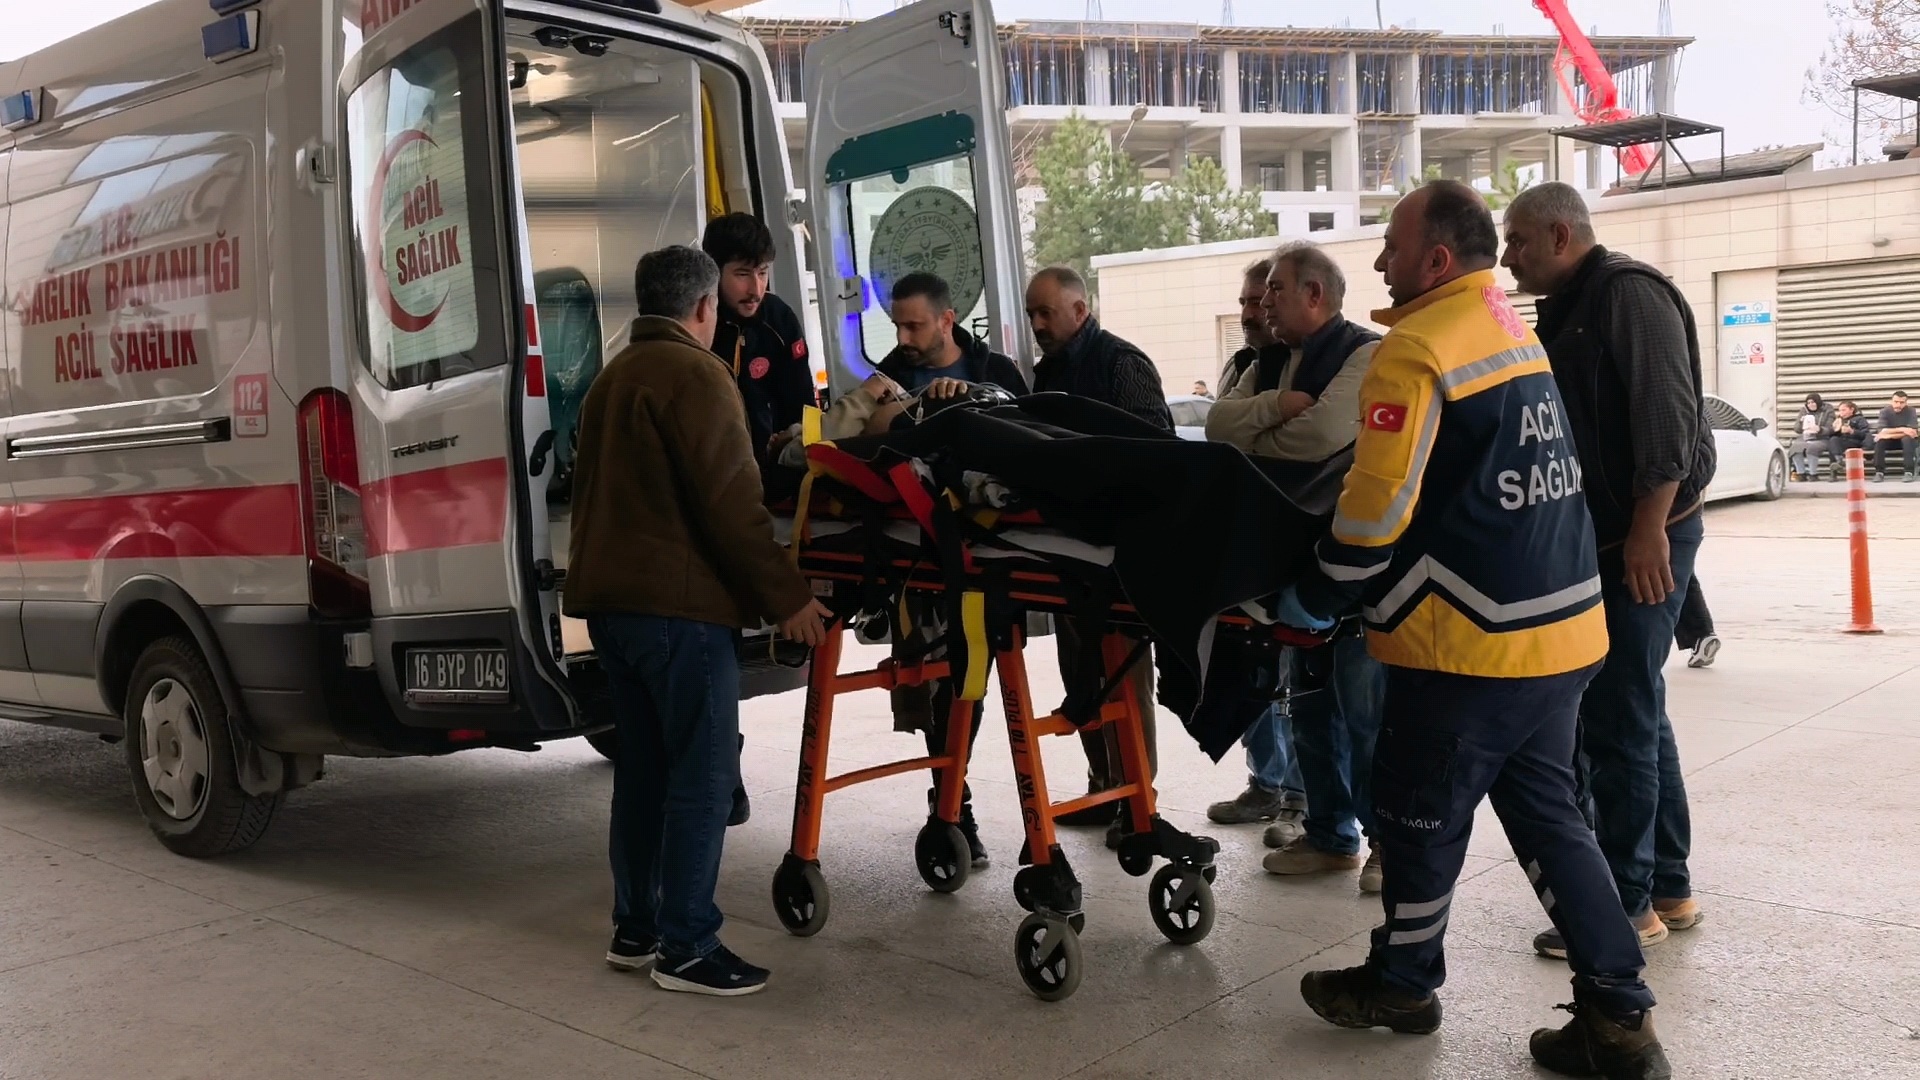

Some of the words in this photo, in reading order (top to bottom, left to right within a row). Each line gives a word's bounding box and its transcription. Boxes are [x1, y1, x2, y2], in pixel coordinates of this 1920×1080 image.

[403, 174, 443, 231] ACİL
[105, 229, 240, 312] BAKANLIĞI
[396, 225, 462, 286] SAĞLIK
[55, 322, 102, 383] ACİL
[110, 311, 198, 375] SAĞLIK
[238, 381, 262, 411] 112
[1519, 391, 1564, 447] ACİL
[414, 653, 430, 688] 16
[437, 653, 466, 688] BYP
[475, 652, 506, 689] 049
